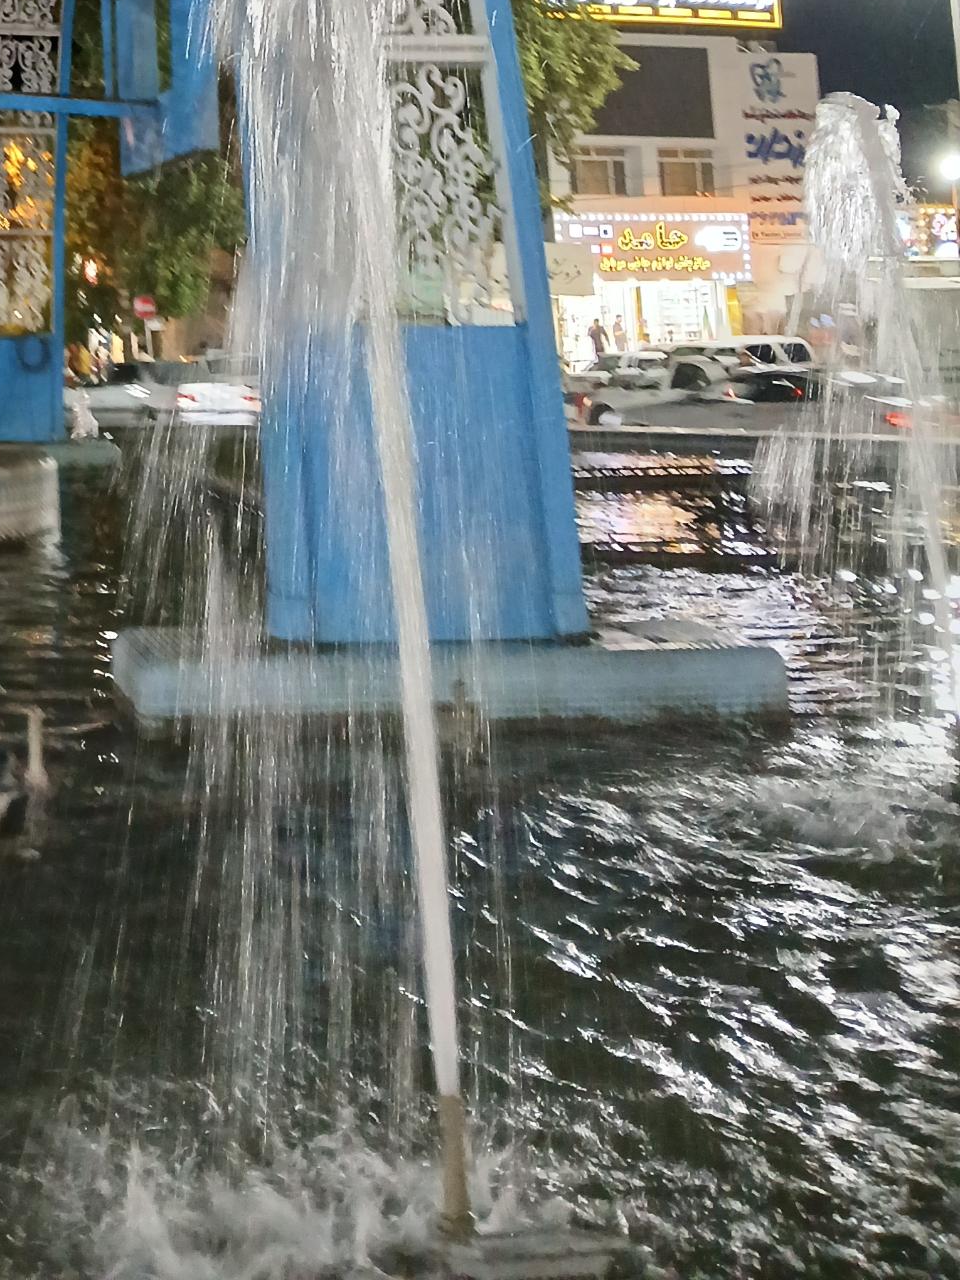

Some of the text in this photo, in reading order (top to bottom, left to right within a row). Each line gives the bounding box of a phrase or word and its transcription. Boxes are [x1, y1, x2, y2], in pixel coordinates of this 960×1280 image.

[617, 221, 689, 251] حامد
[599, 256, 627, 272] موبایل
[627, 255, 651, 272] جانبی
[651, 256, 674, 271] لوازم
[674, 255, 693, 272] پخش
